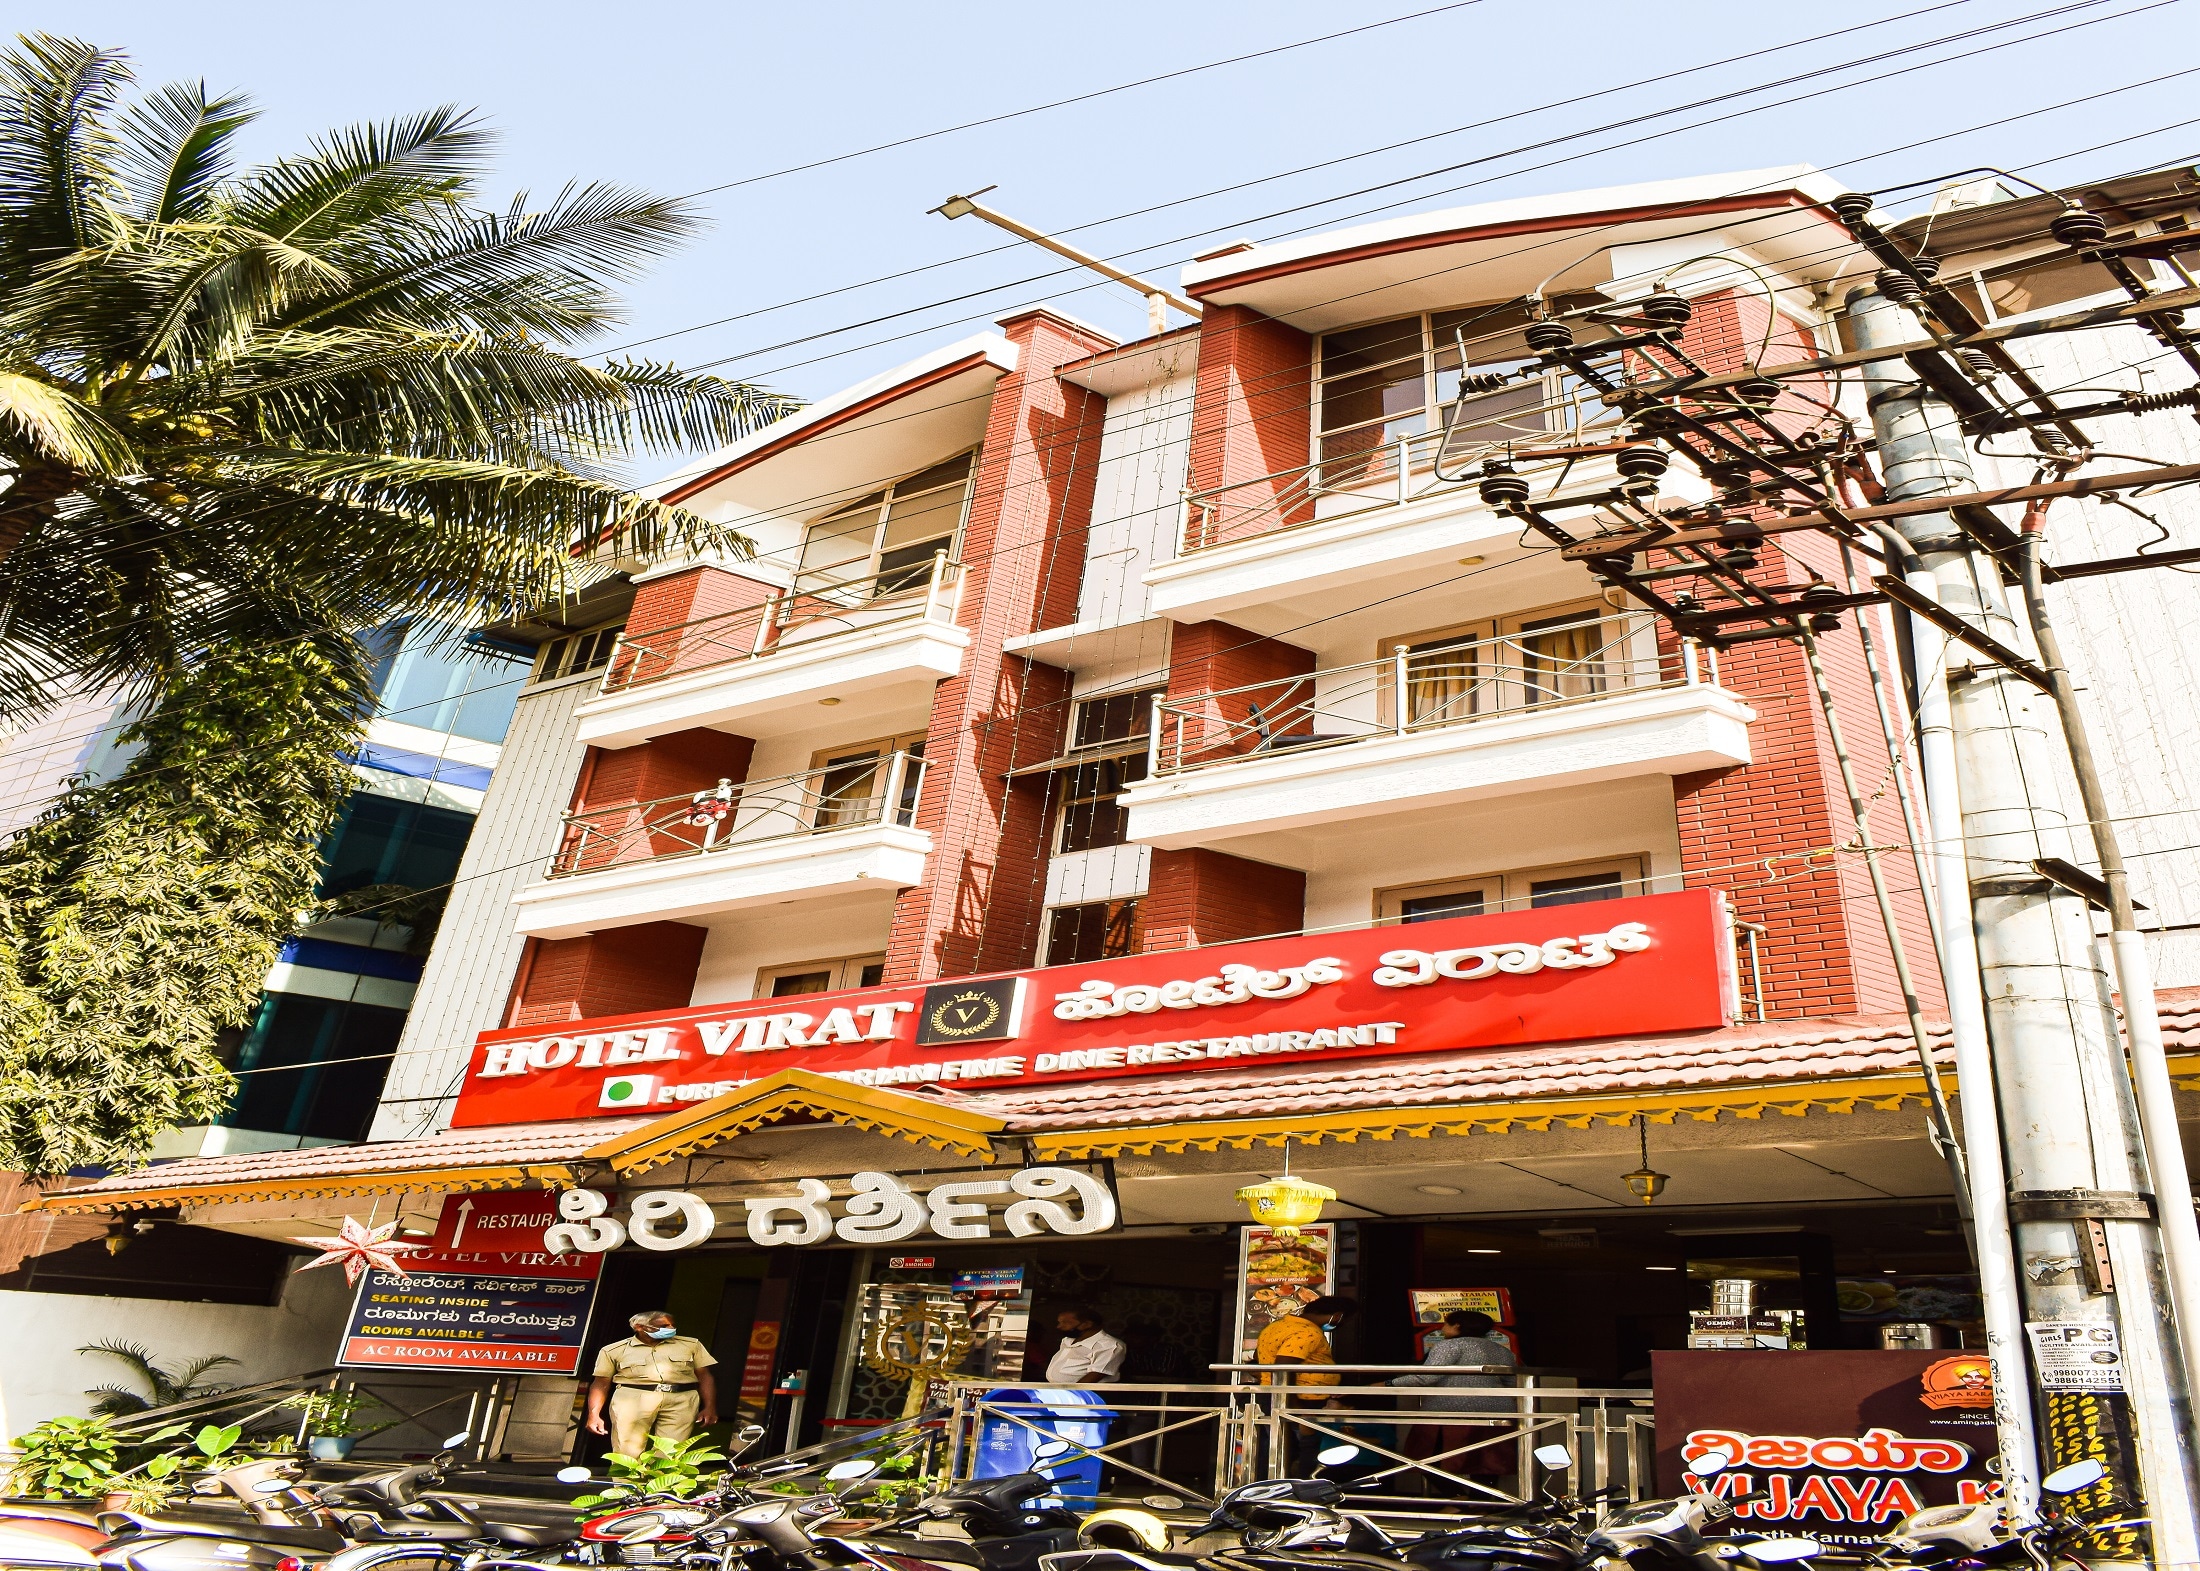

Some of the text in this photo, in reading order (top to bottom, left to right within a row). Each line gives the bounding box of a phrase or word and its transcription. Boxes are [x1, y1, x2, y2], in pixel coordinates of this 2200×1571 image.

[1052, 922, 1652, 1022] ಹೋಟೆಲ್ ವಿರಾಟ್
[955, 1006, 979, 1024] V
[476, 1001, 915, 1079] HOTEL VIRAT
[657, 1080, 741, 1104] PURE
[940, 1055, 1027, 1081] FINE
[1034, 1046, 1127, 1074] DINE
[1127, 1022, 1405, 1065] RESTAURANT
[477, 1213, 585, 1229] RESTAUR
[543, 1188, 716, 1256] ಸಿರಿ
[500, 1251, 588, 1267] VIRAT
[544, 1283, 586, 1295] ಹಾಲ್
[370, 1294, 490, 1307] SEATING INSIDE
[360, 1325, 485, 1339] ROOMS AVAILBLE
[2040, 1335, 2062, 1343] GIRLS
[362, 1345, 558, 1363] AC ROOM AVAILABLE
[1930, 1391, 1963, 1400] VIJAYA
[1681, 1428, 1970, 1474] ವಿಜಯಾ
[1682, 1471, 1922, 1524] VIJAYA
